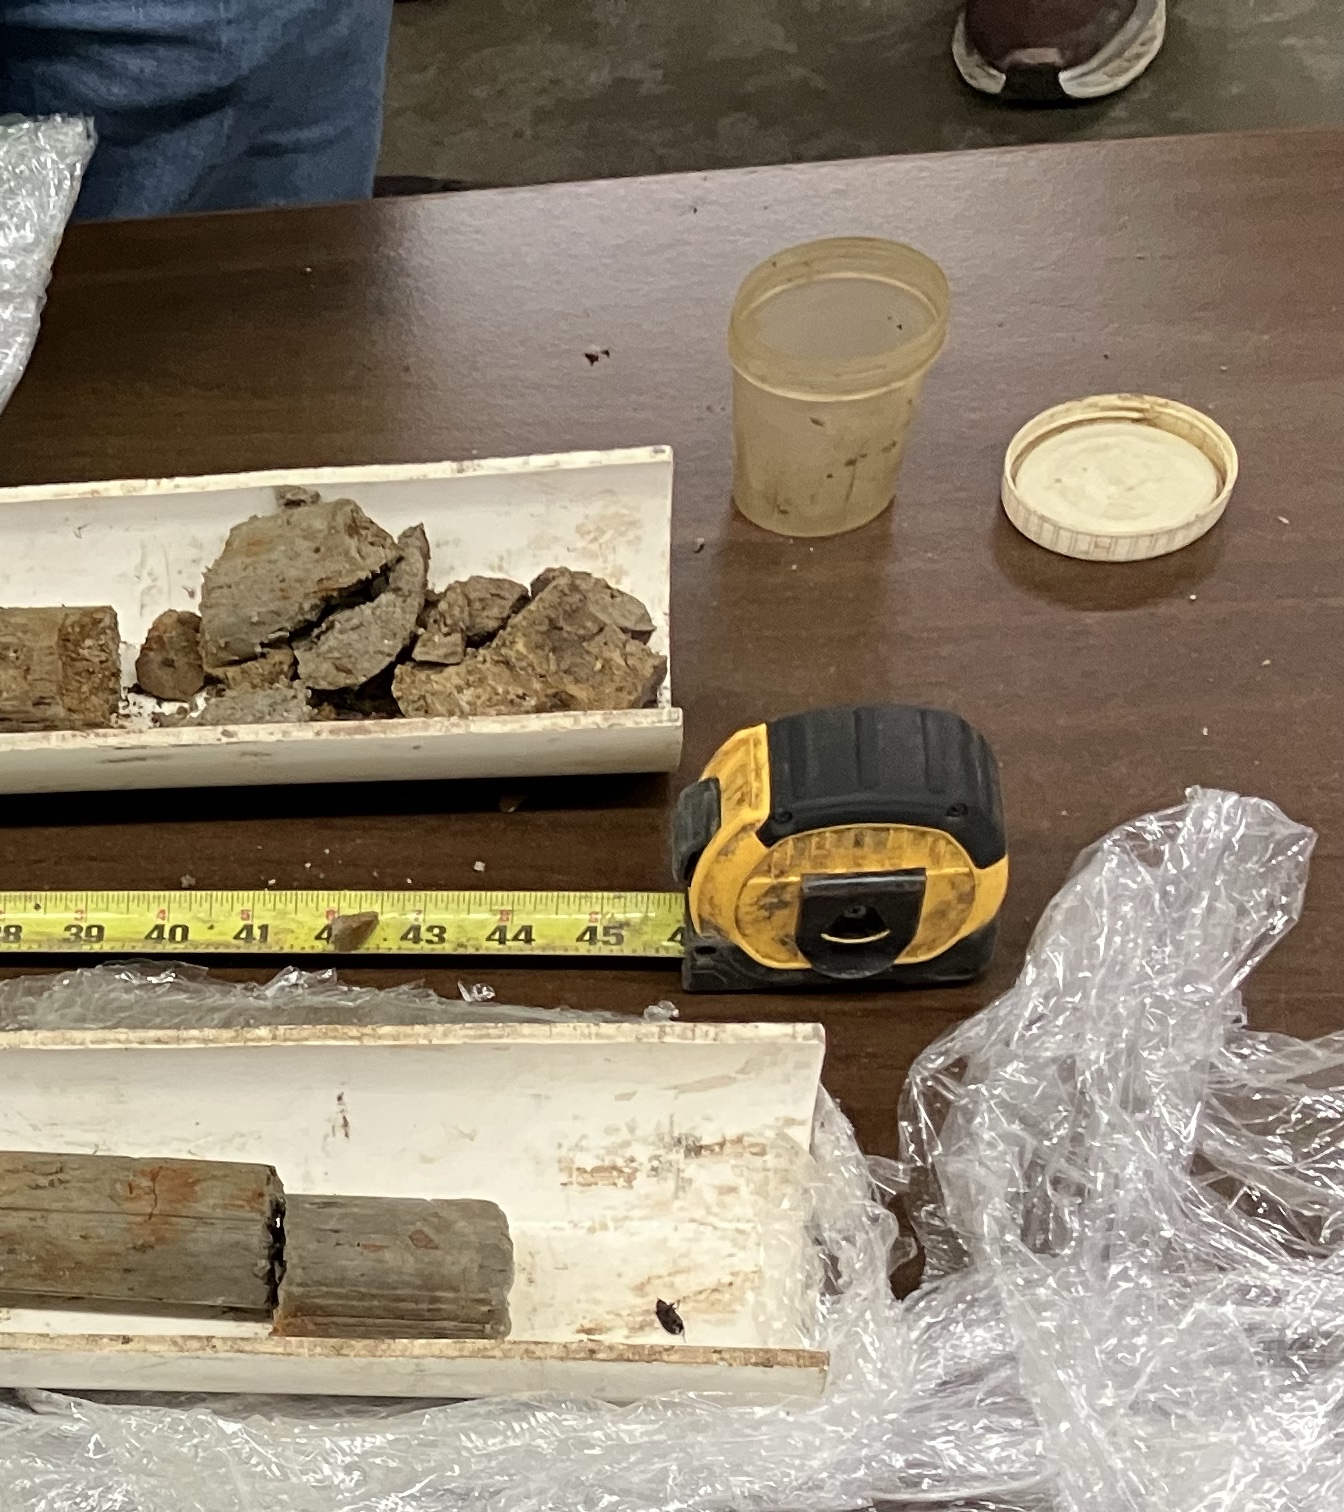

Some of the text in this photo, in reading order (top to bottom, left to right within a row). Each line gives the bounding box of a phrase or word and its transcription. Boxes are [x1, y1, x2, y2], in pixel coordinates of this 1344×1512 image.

[63, 924, 105, 944] 39
[144, 924, 190, 944] 40
[233, 924, 269, 944] 41
[314, 923, 332, 944] 4
[400, 924, 447, 944] 43
[485, 925, 536, 945] 44
[576, 925, 625, 946] 45
